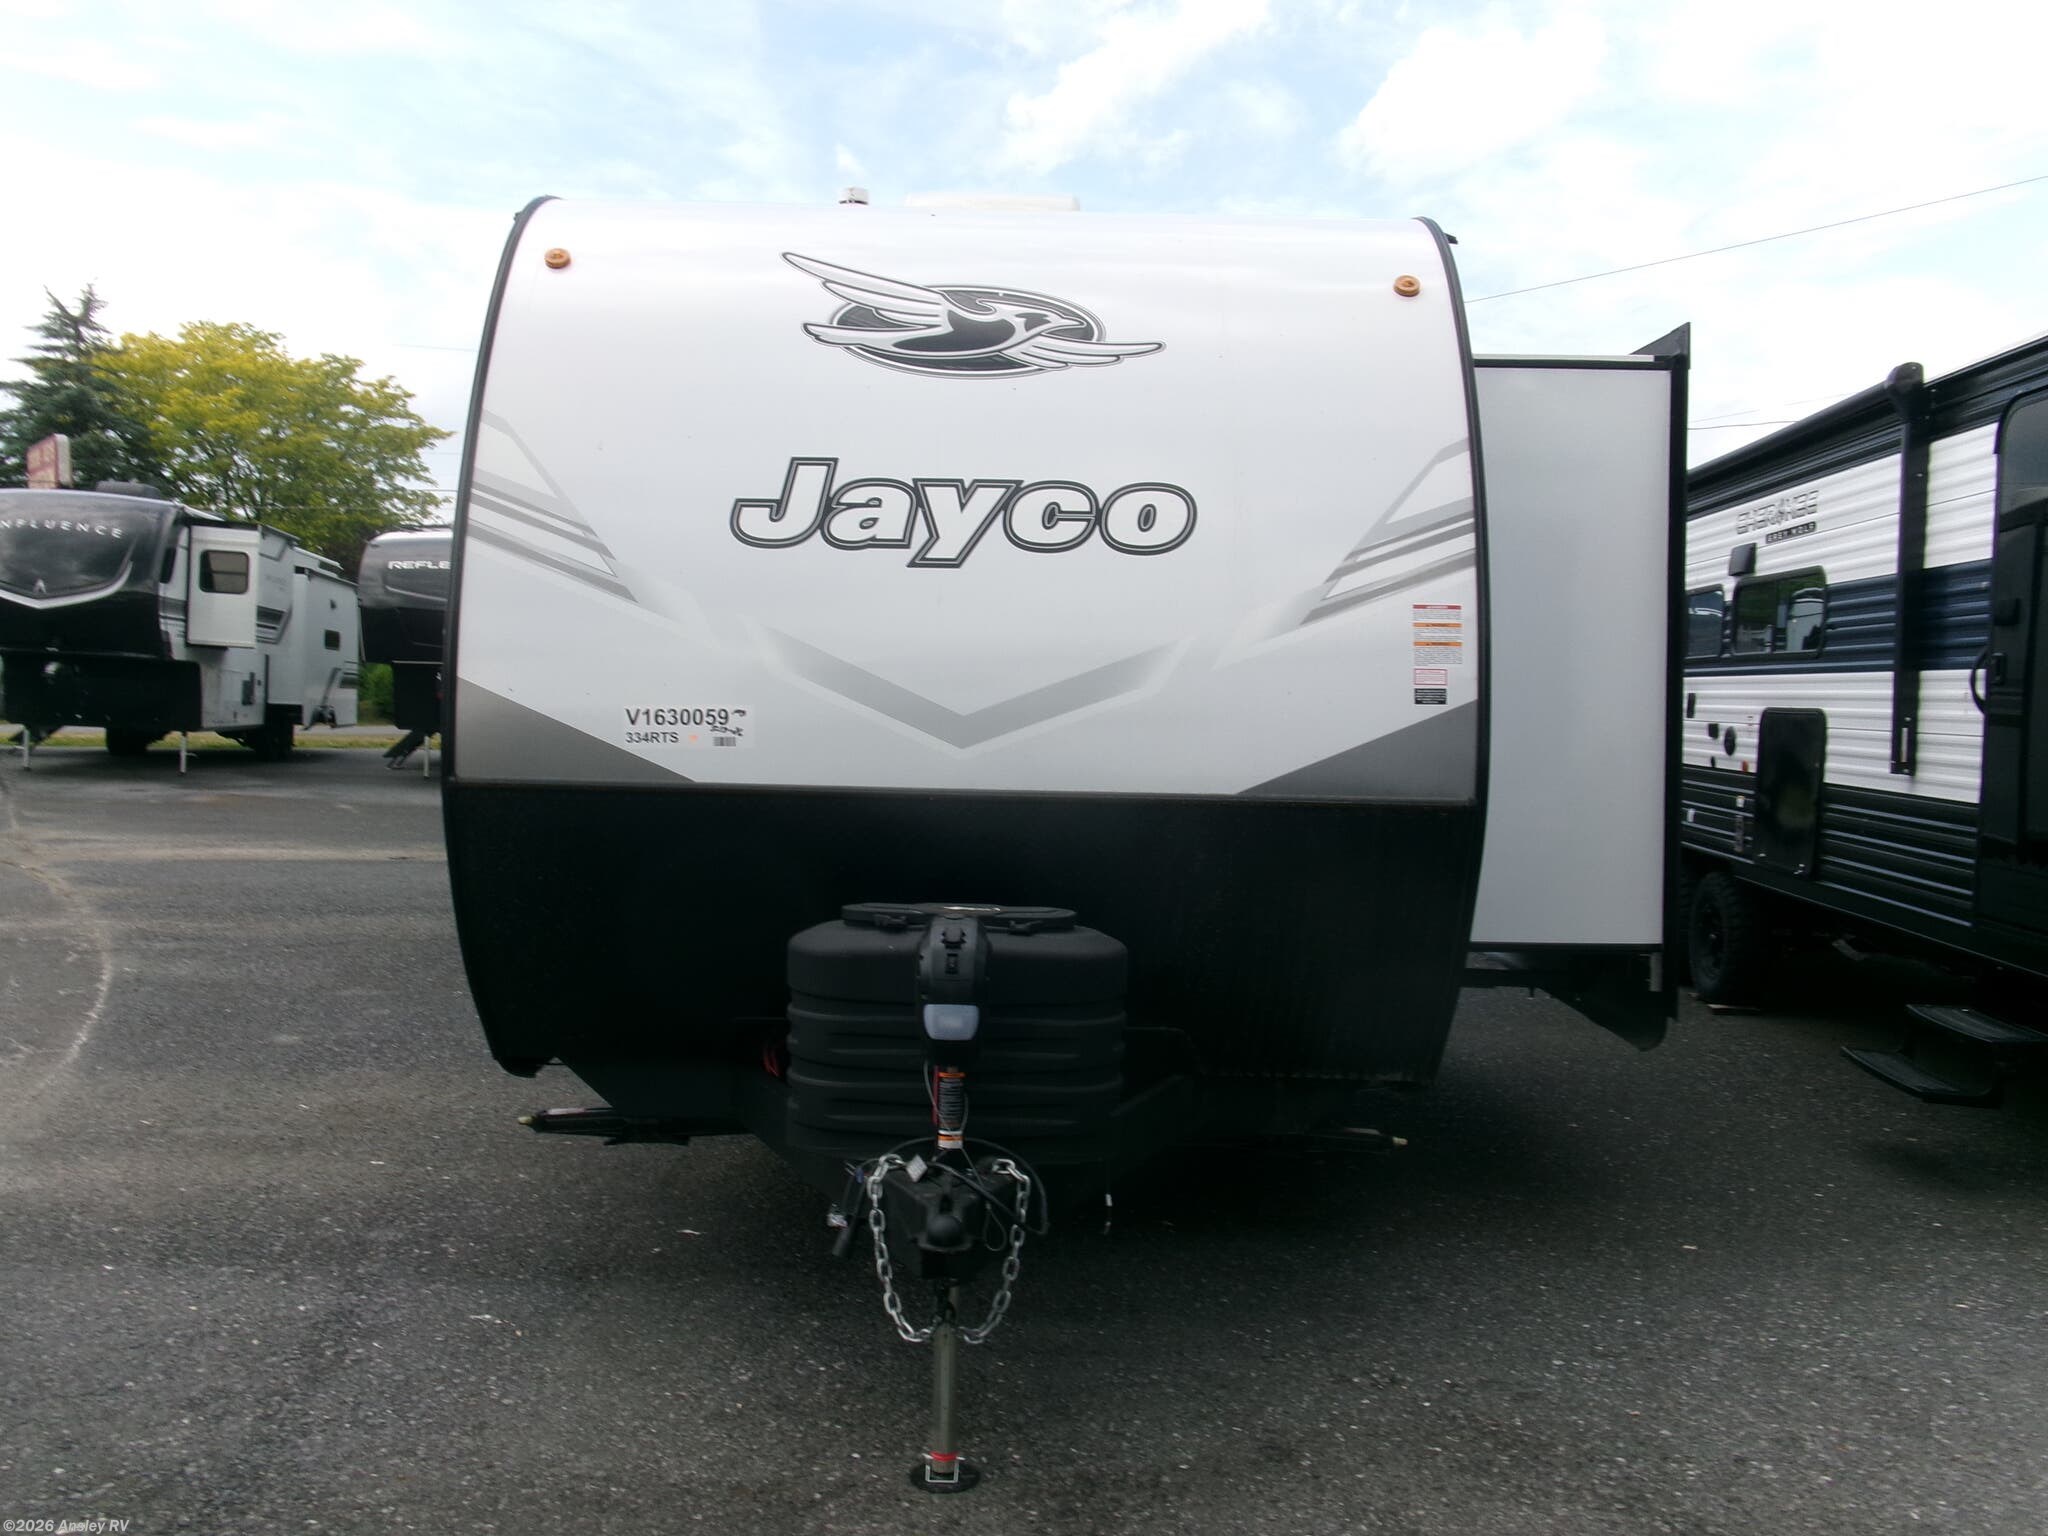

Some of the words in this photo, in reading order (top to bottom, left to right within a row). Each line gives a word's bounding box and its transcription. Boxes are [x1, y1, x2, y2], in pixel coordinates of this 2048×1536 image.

[730, 457, 1197, 568] Jayco
[0, 519, 123, 538] NFLUENCE
[388, 560, 451, 569] REFLE
[625, 708, 729, 726] V1630059
[625, 731, 679, 743] 334RTS
